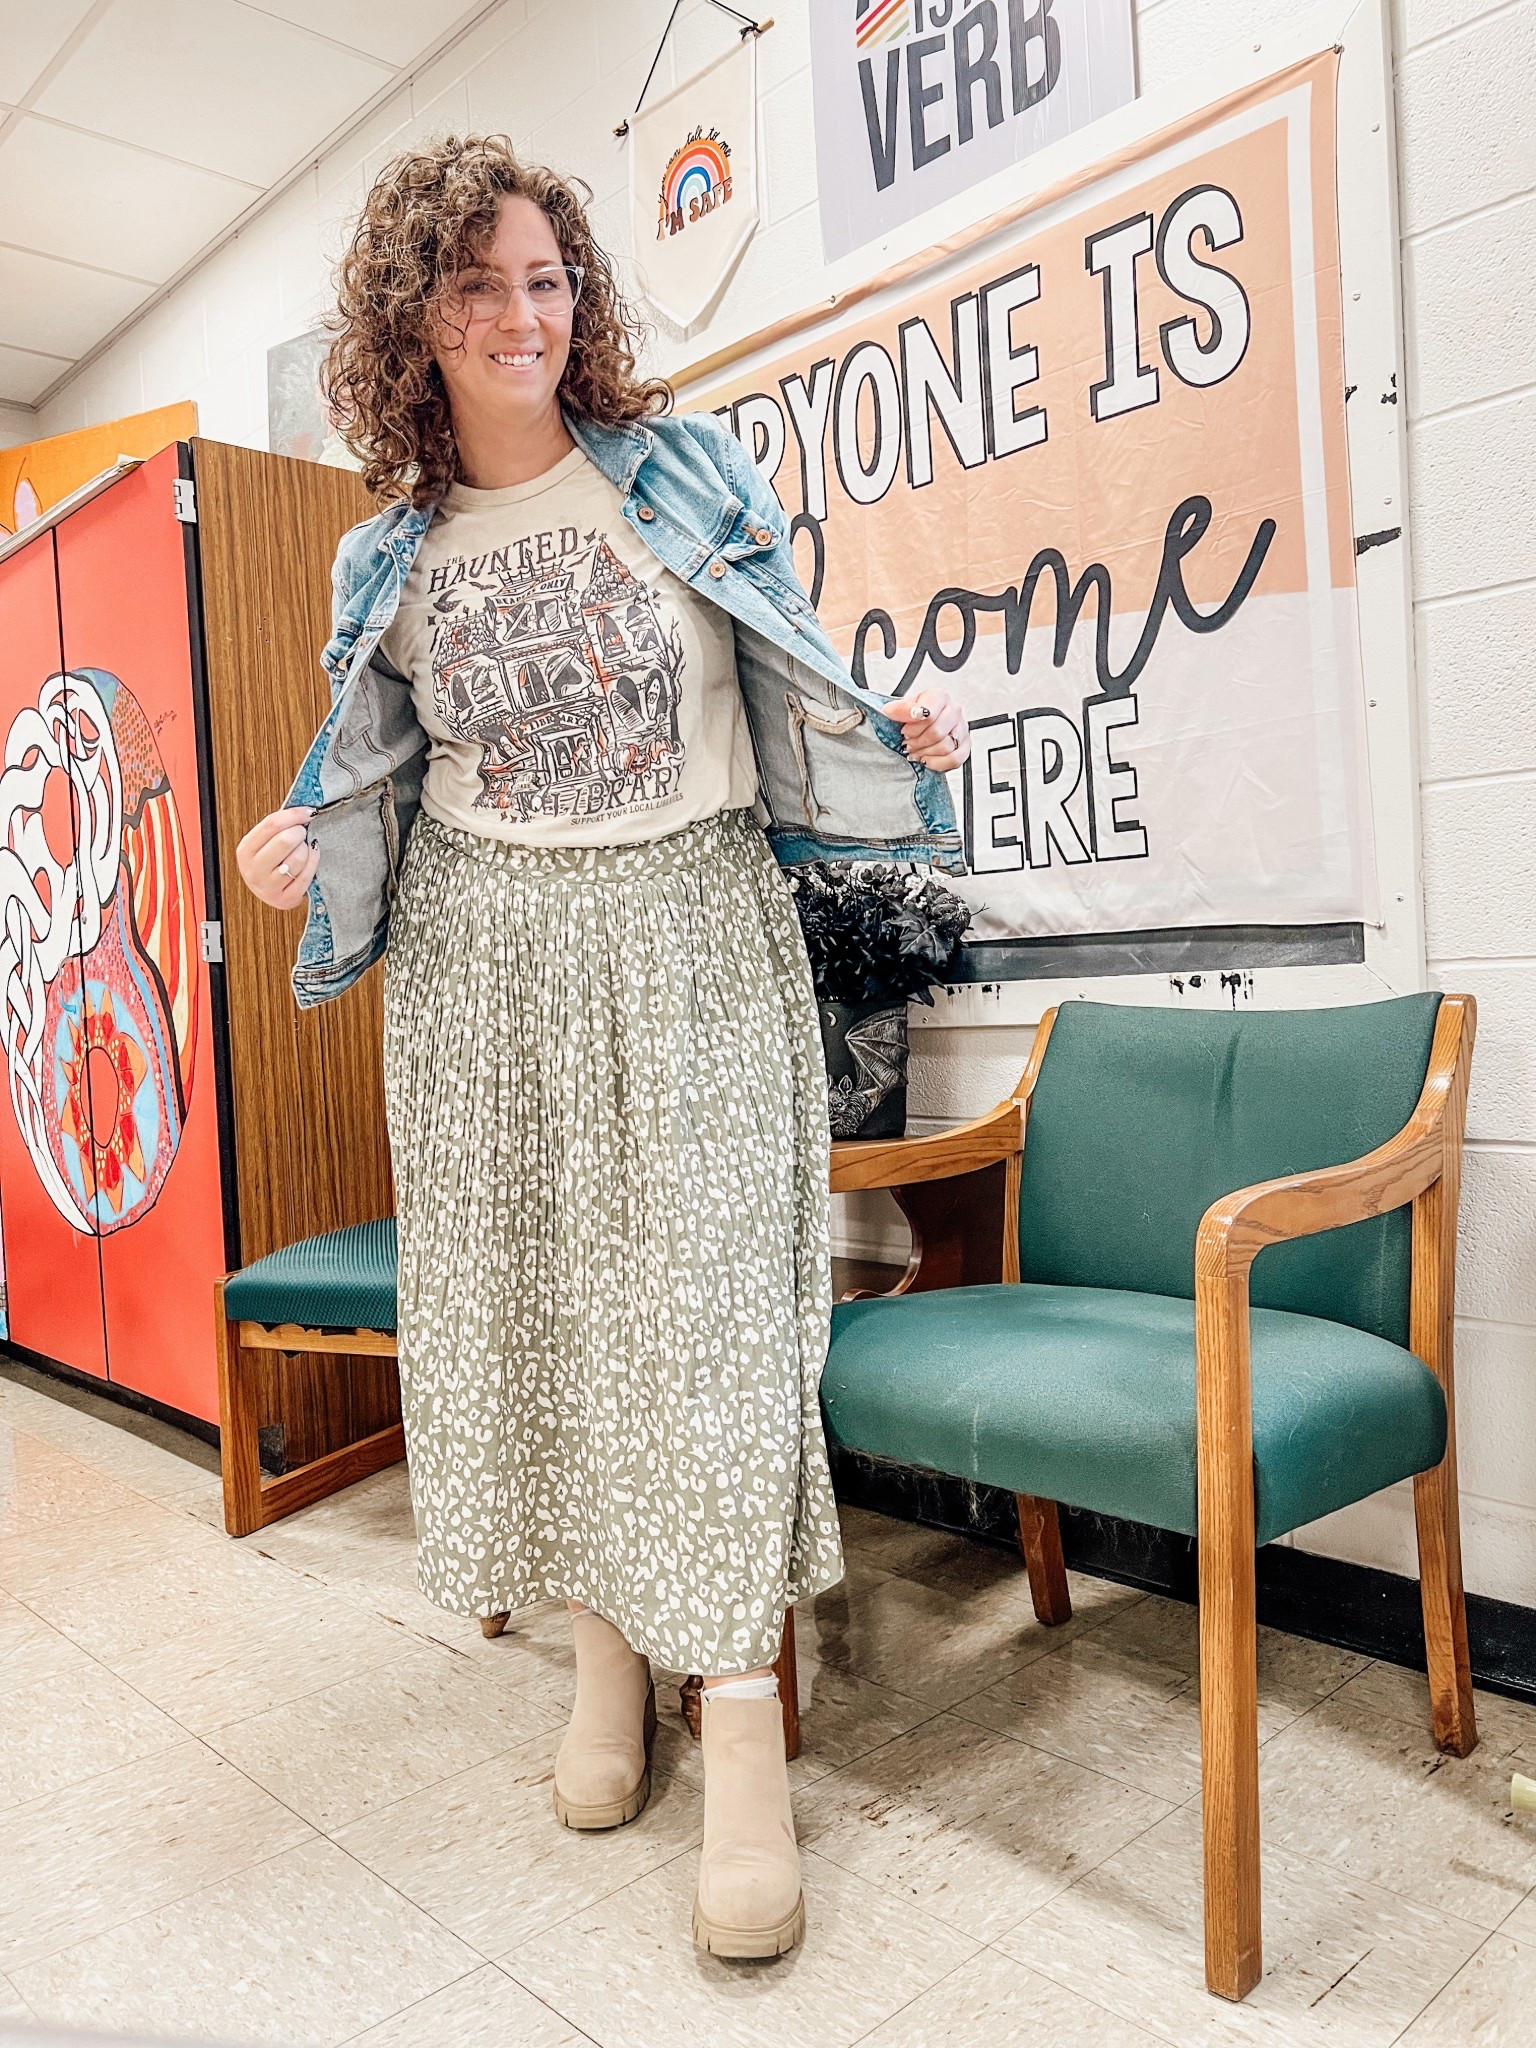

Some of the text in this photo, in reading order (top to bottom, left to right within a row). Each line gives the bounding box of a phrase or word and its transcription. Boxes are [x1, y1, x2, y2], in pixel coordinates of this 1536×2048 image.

[858, 0, 1062, 192] VERB
[684, 125, 702, 149] talk
[705, 127, 720, 141] to
[656, 177, 733, 241] I'M SAFE
[712, 185, 1252, 522] RYONE IS
[427, 526, 578, 594] HAUNTED
[446, 554, 465, 566] THE
[540, 577, 568, 591] ONLY
[549, 761, 686, 818] LIBRARY
[571, 813, 605, 826] SUPPORT
[607, 808, 628, 820] YOUR
[630, 803, 655, 814] LOCAL
[962, 693, 1149, 876] ERE
